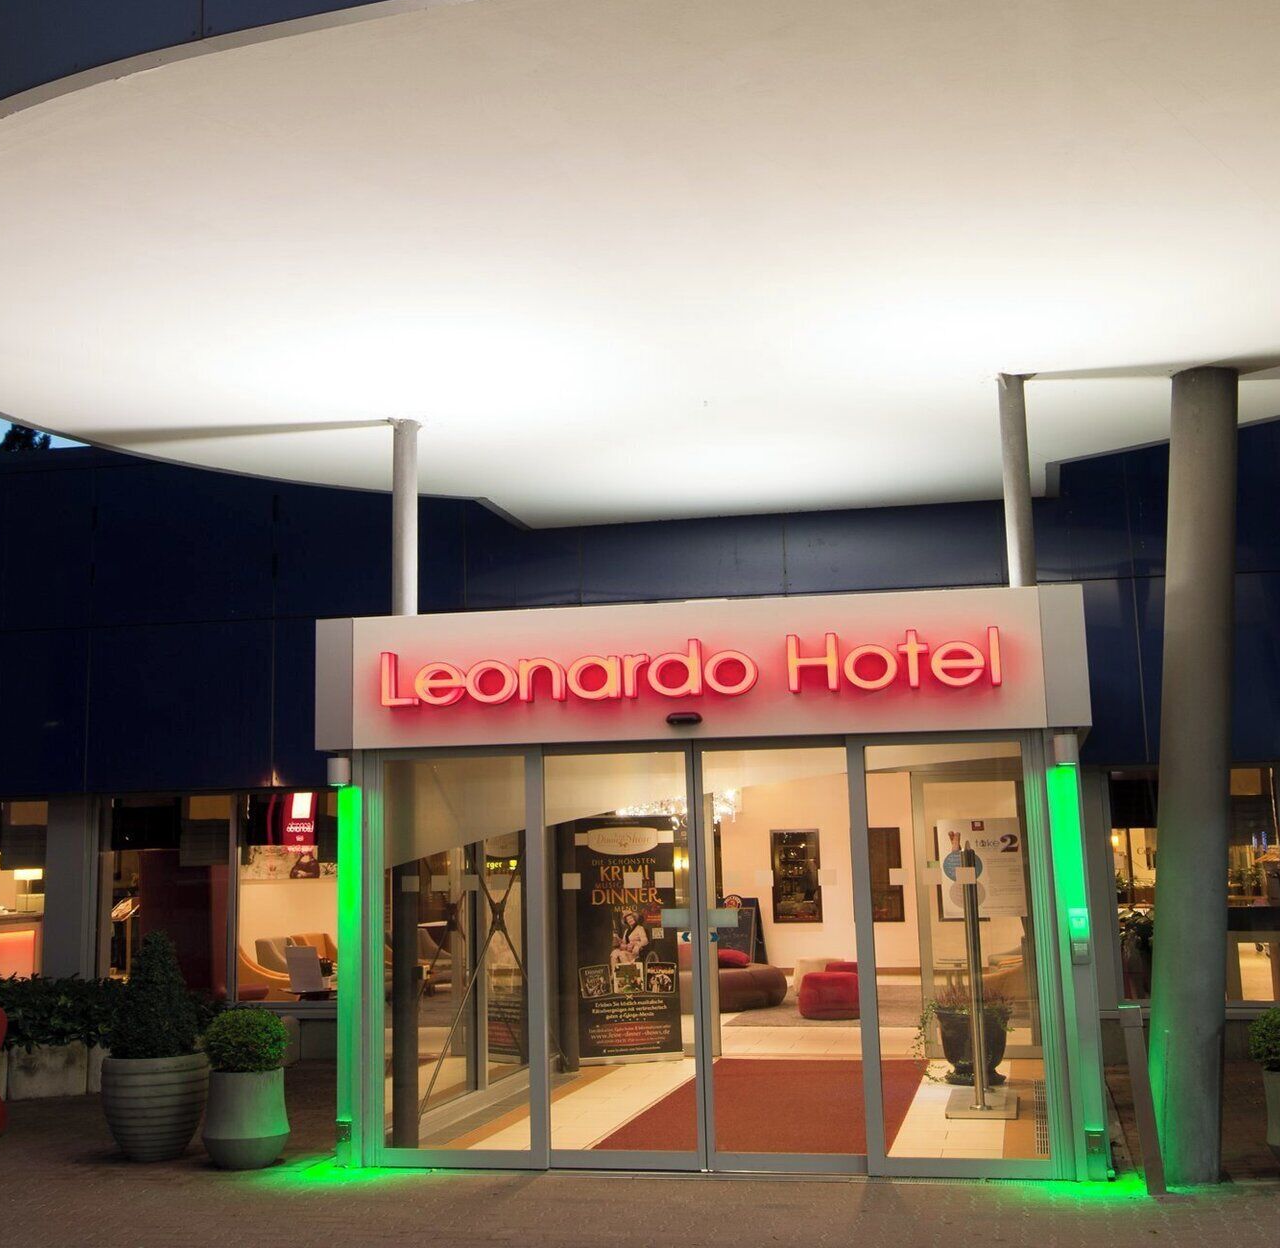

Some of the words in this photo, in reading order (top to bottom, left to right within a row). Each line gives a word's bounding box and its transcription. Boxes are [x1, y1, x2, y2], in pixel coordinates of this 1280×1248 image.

[380, 638, 758, 708] Leonardo
[786, 626, 1003, 693] Hotel
[1000, 834, 1019, 852] 2
[591, 887, 664, 906] DINNER
